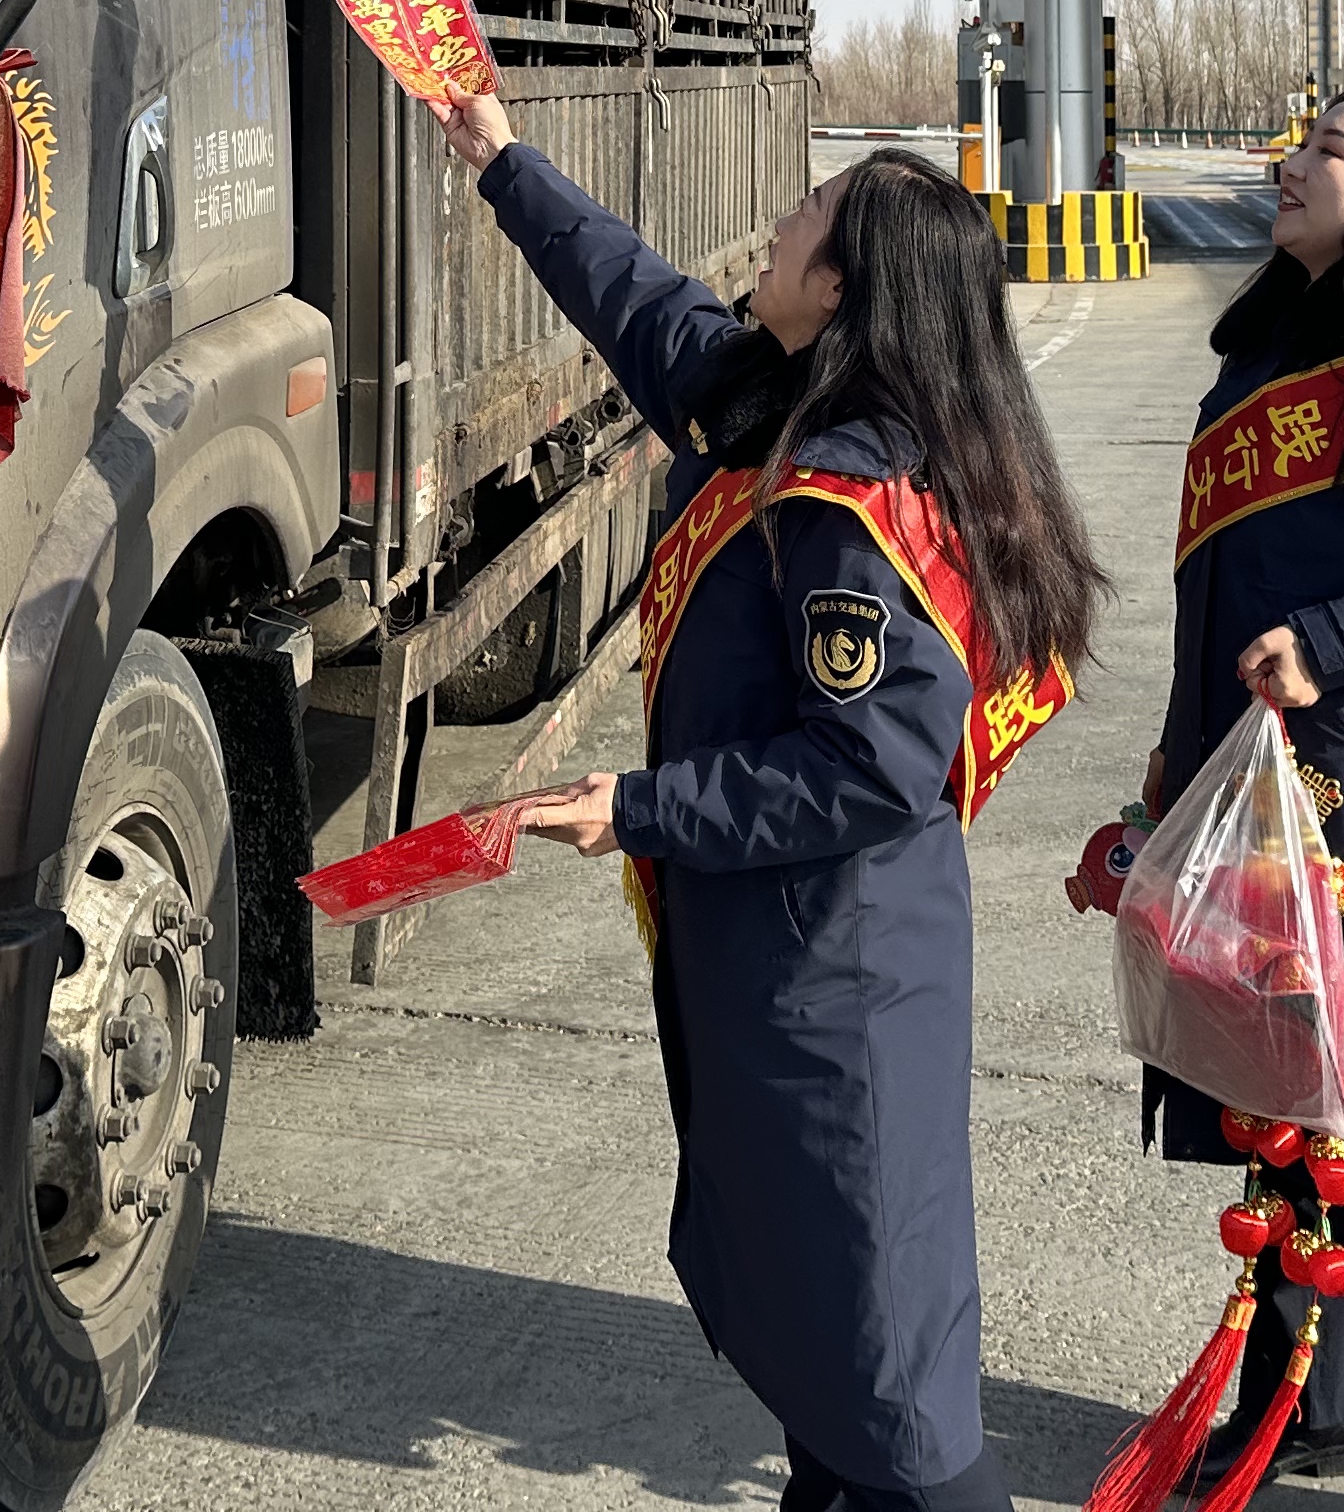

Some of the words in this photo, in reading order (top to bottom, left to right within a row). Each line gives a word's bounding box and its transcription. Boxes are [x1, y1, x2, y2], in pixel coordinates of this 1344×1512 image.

[1179, 399, 1331, 533] 践行文
[810, 600, 880, 622] 内蒙古交通集团
